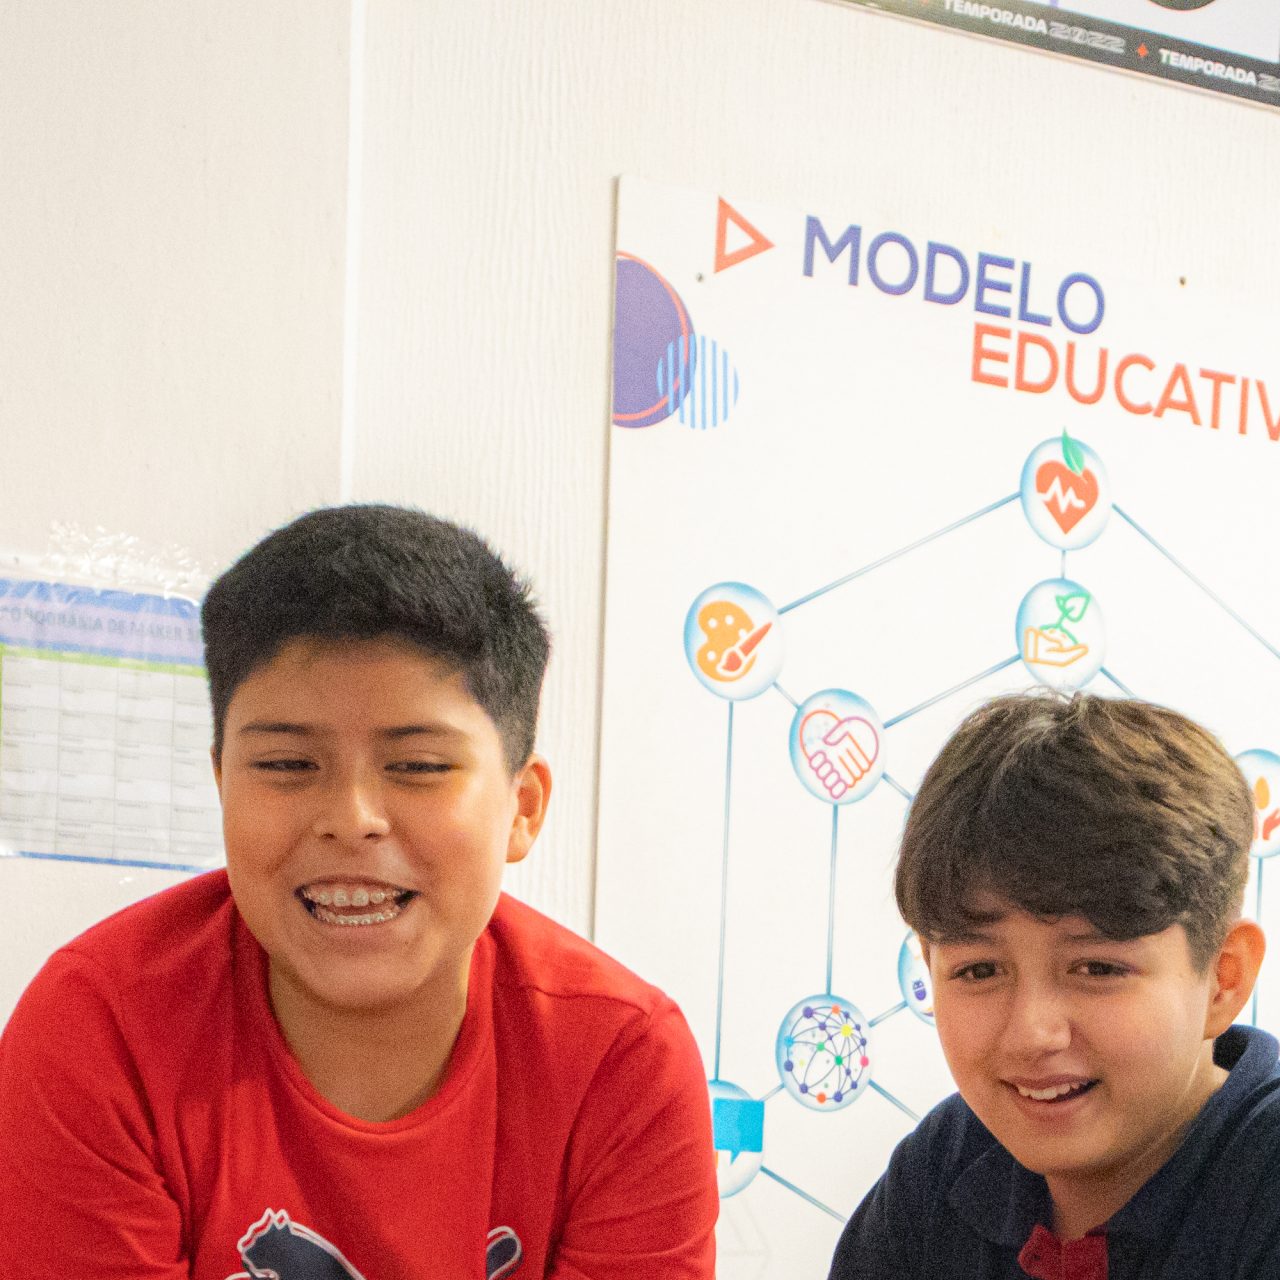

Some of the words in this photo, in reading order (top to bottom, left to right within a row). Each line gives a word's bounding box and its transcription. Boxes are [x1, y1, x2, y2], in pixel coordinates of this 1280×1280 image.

[943, 0, 1048, 35] TEMPORADA
[1158, 48, 1257, 86] TEMPORADA
[802, 214, 1106, 335] MODELO
